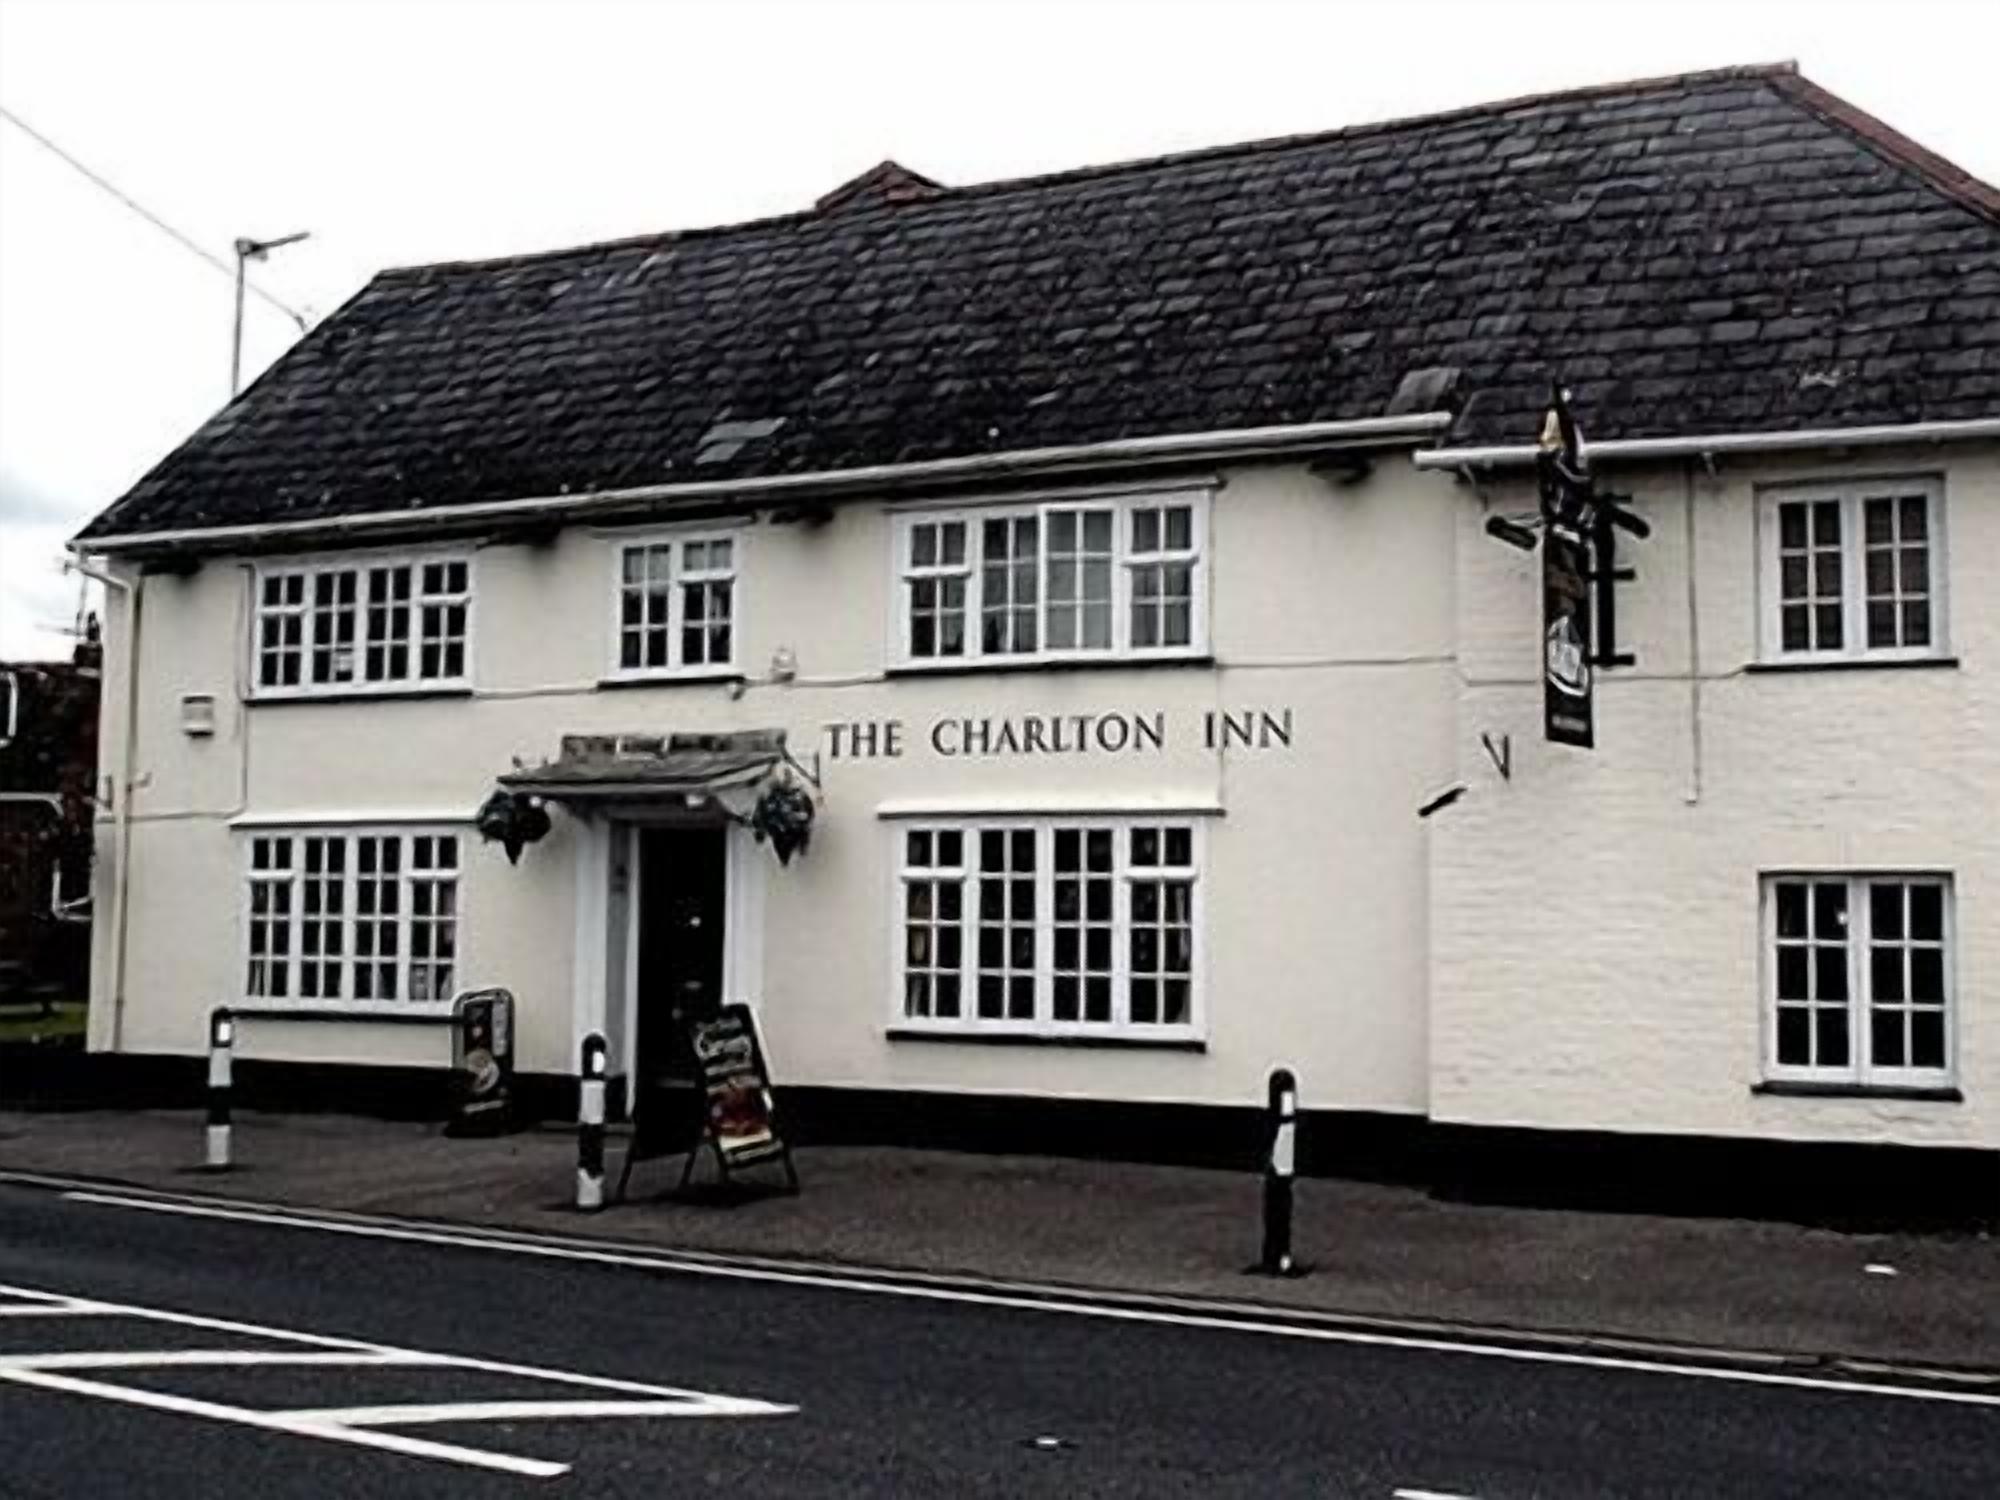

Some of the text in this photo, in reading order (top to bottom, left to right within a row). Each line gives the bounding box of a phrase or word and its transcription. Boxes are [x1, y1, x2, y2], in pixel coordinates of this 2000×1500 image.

[825, 710, 1293, 758] THE CHARLTON INN
